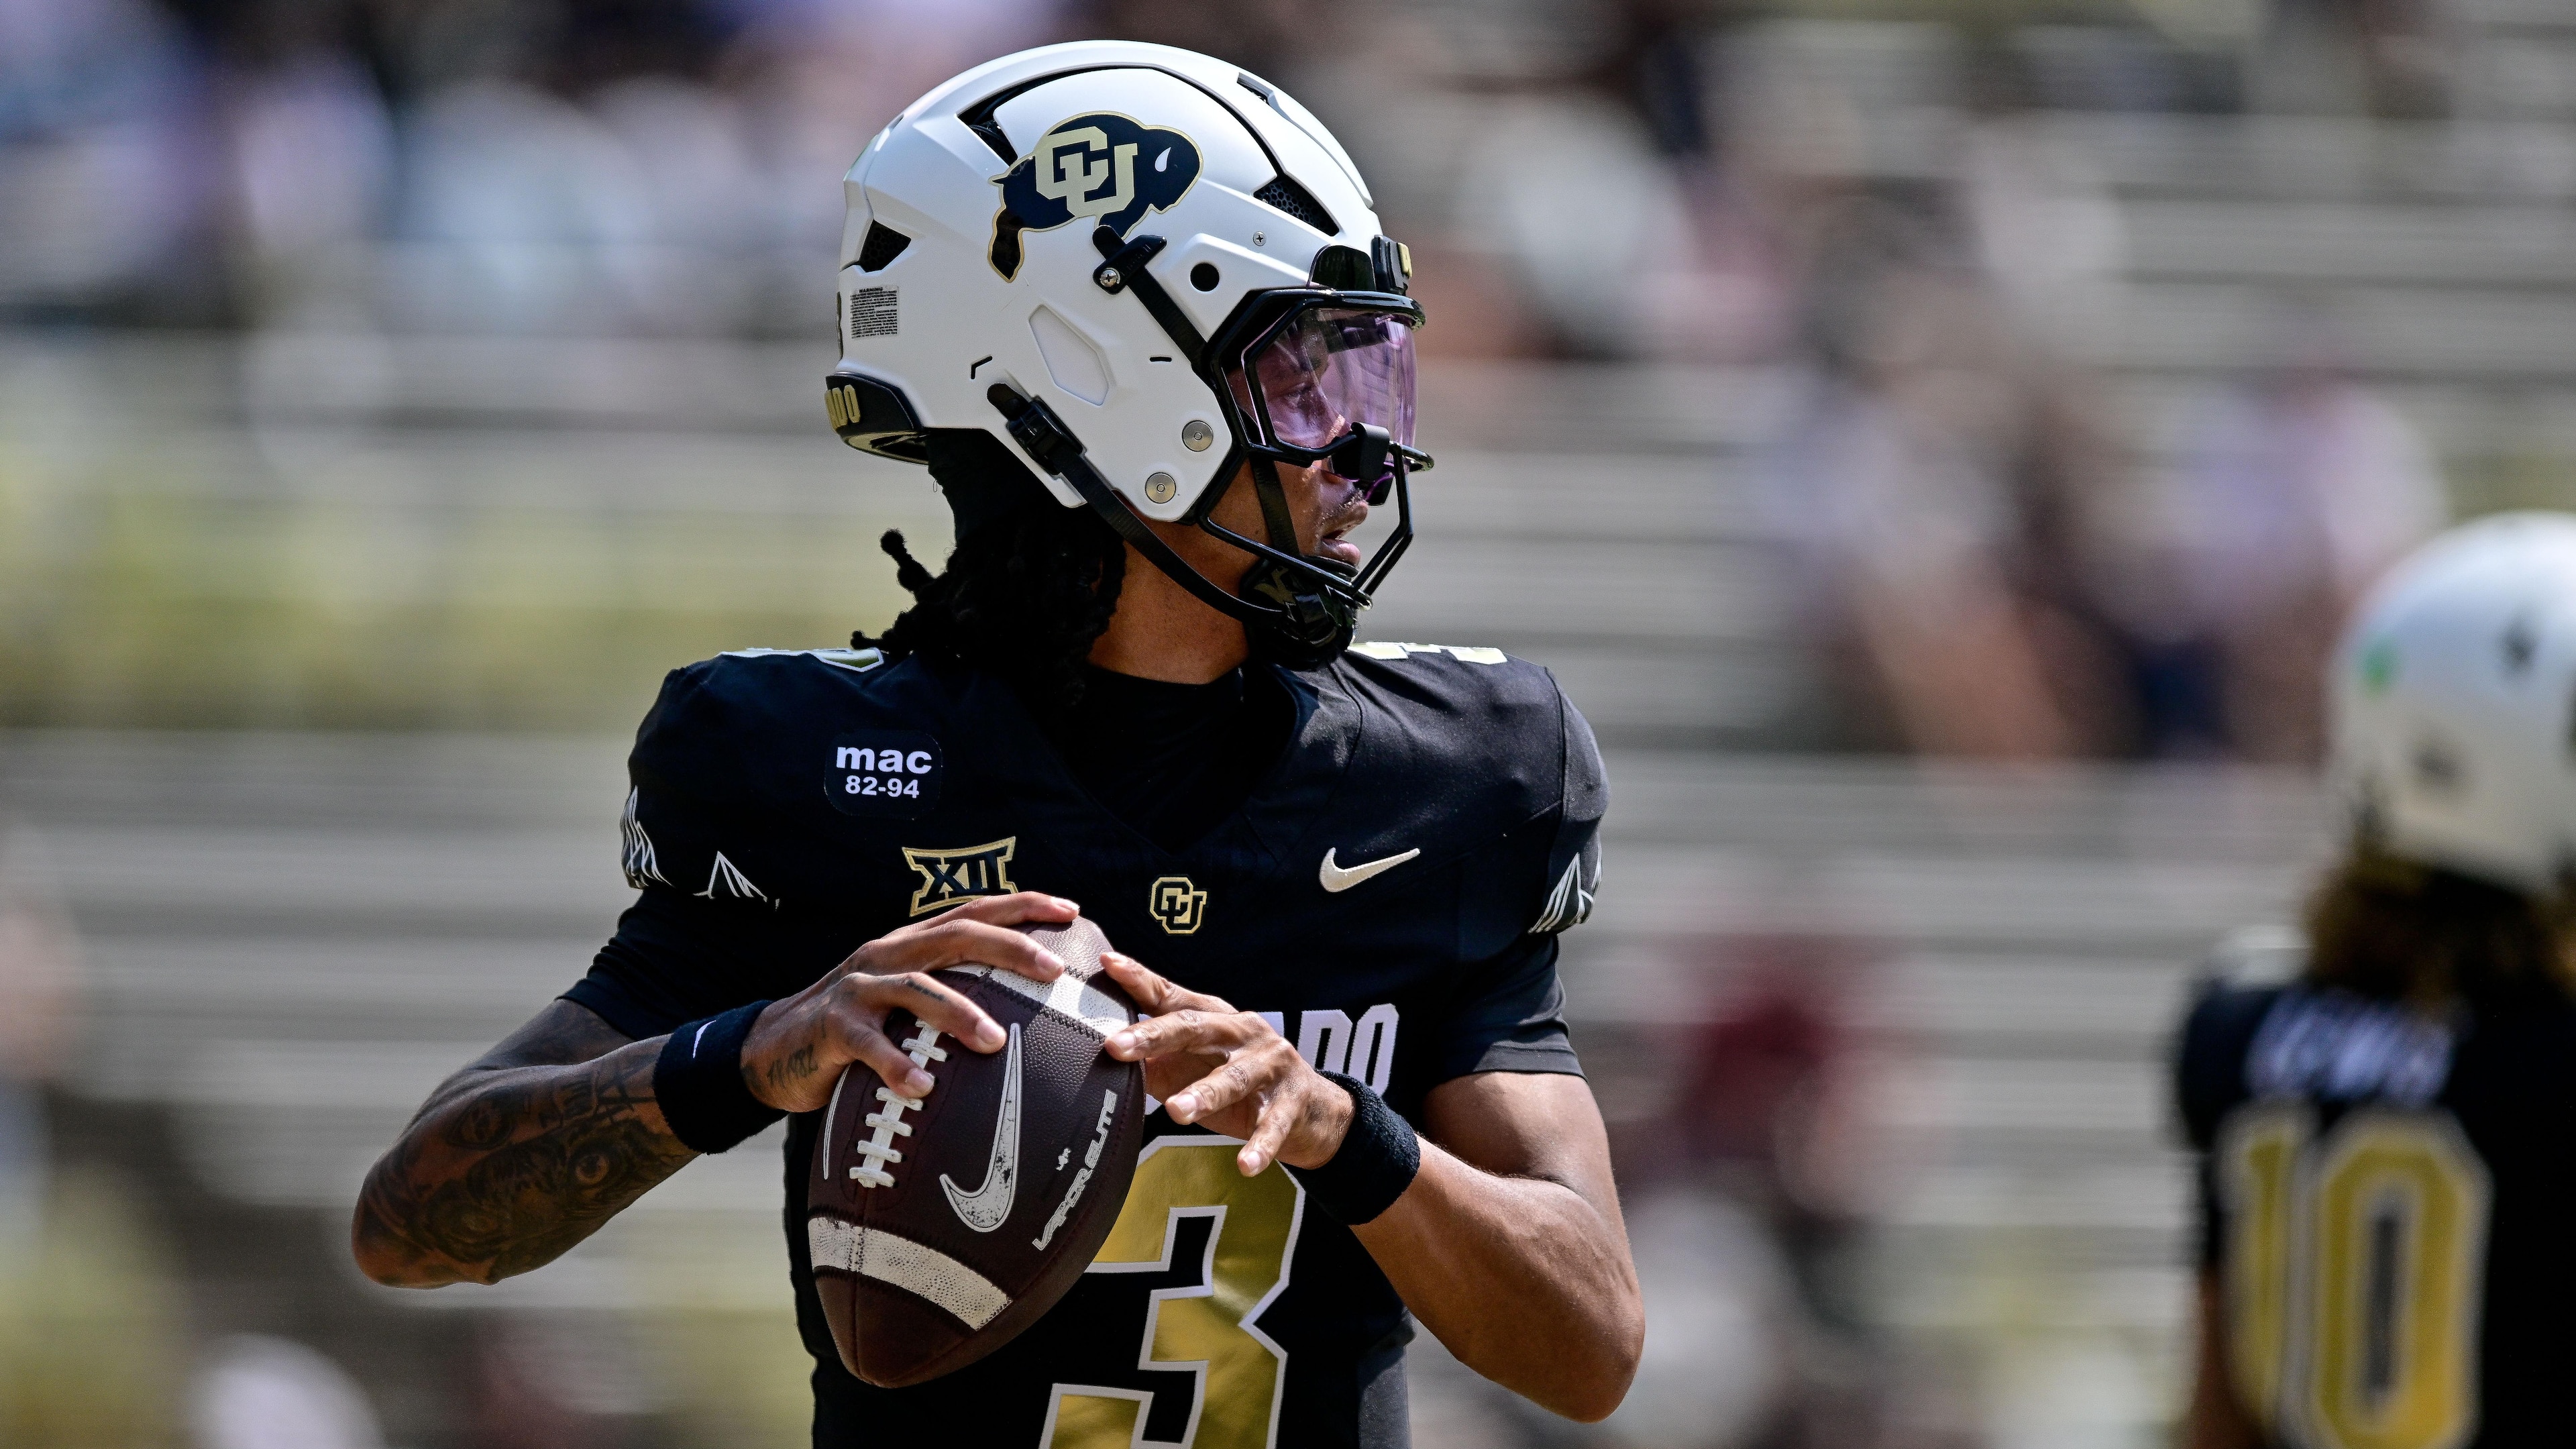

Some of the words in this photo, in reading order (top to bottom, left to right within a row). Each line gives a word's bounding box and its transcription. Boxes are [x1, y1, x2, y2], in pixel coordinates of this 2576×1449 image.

[1035, 125, 1138, 217] CU
[836, 746, 932, 774] mac
[845, 775, 920, 799] 82-94
[1150, 877, 1208, 934] CU
[1031, 1168, 1093, 1251] VAPOR
[1084, 1088, 1118, 1169] ELITE
[1038, 1134, 1306, 1449] 3
[2217, 1100, 2497, 1449] 10
